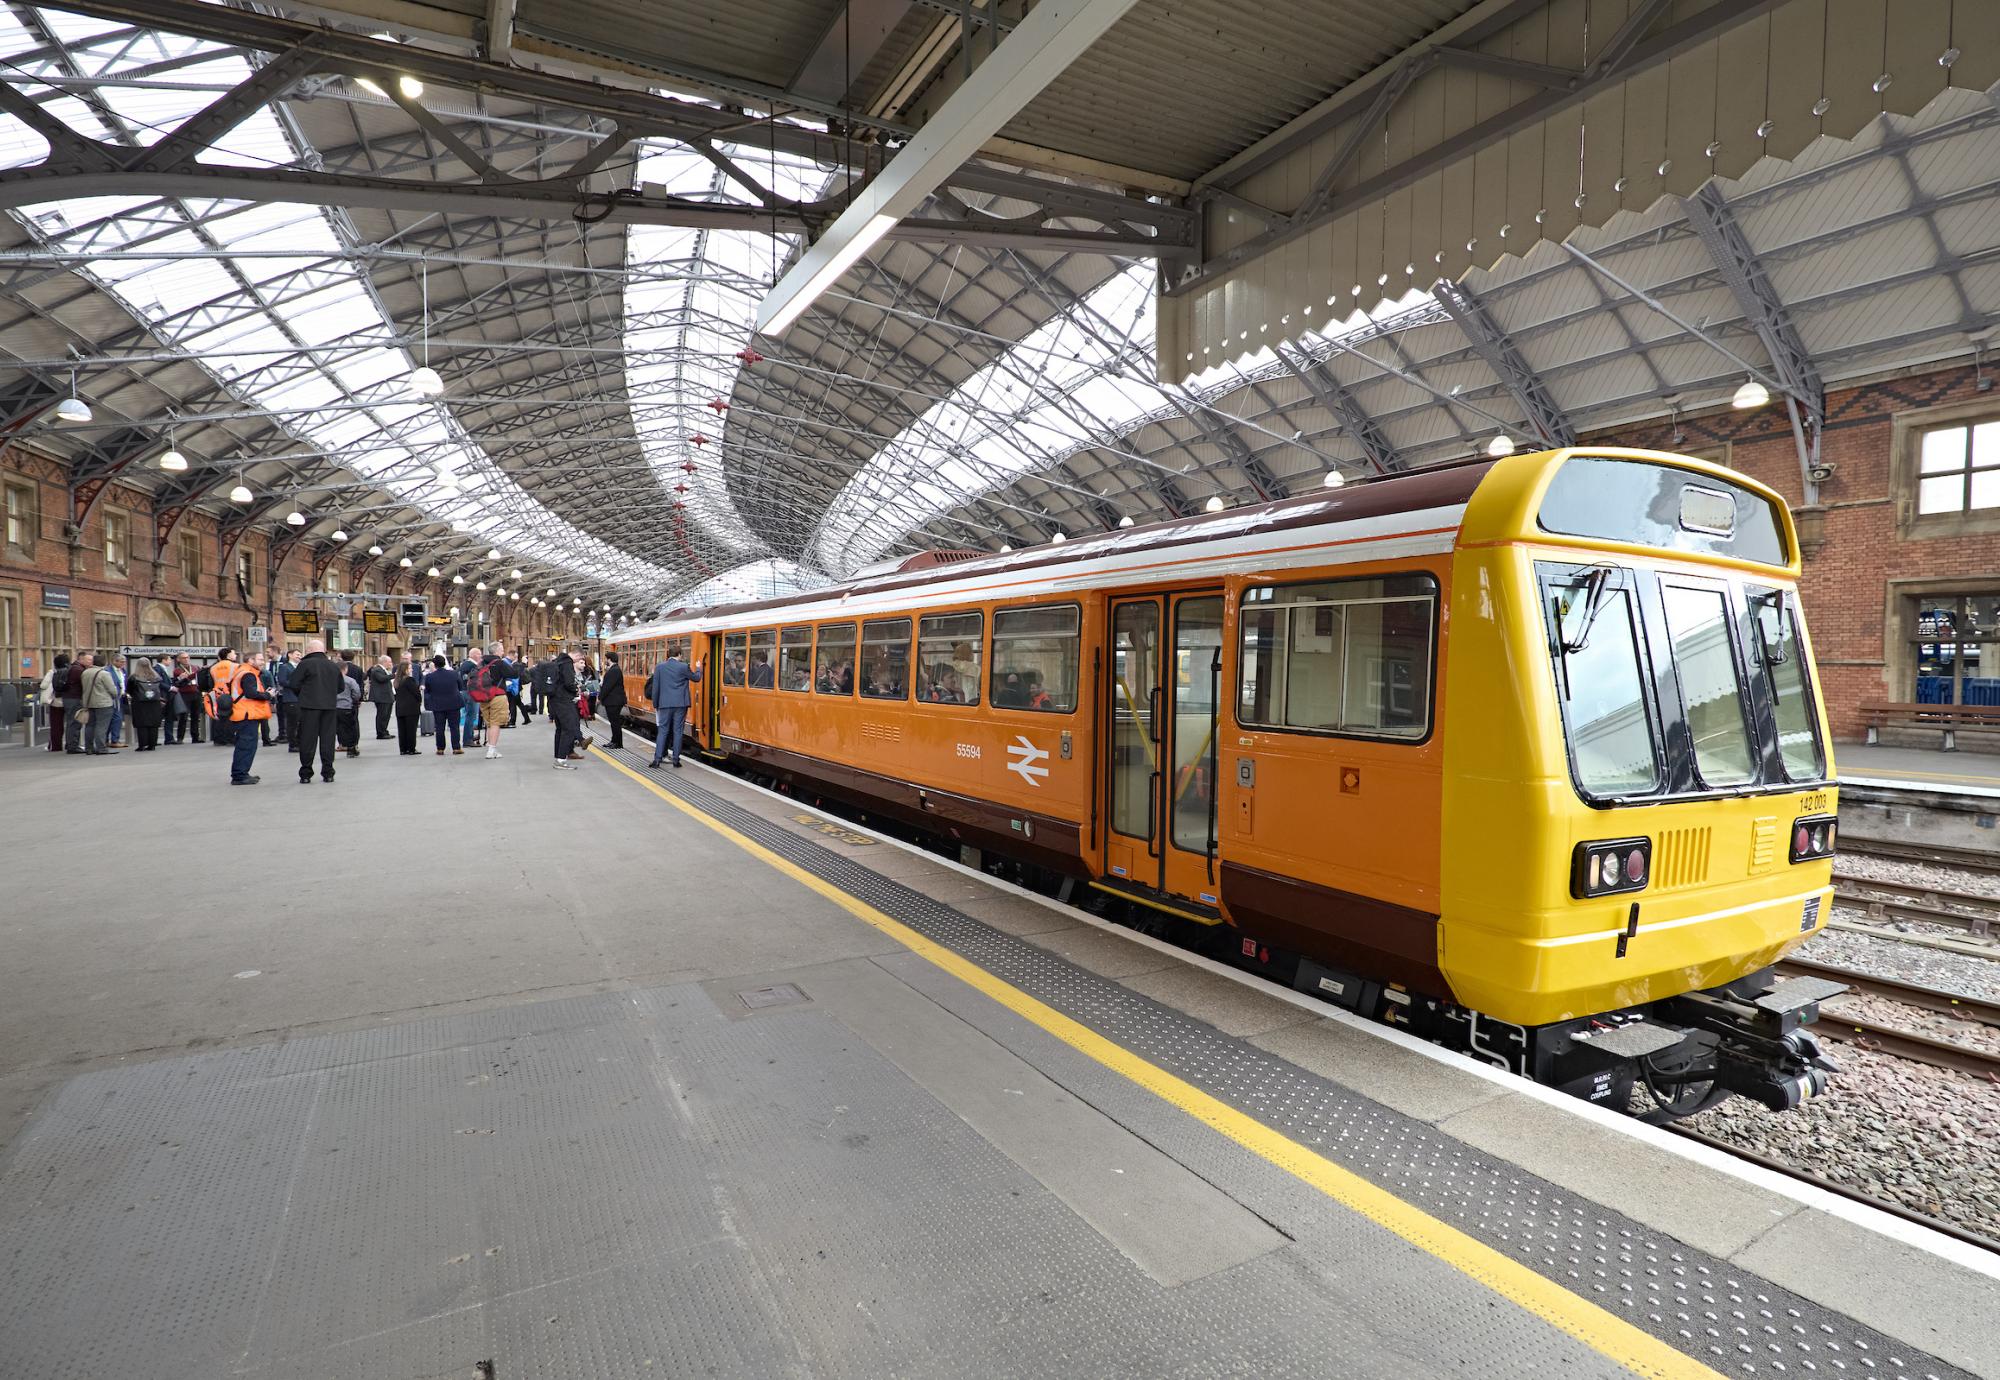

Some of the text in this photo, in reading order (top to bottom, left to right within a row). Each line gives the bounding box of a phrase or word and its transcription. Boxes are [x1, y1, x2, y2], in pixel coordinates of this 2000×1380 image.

[956, 743, 981, 759] 55594
[1800, 793, 1827, 812] 142 003
[1590, 1089, 1612, 1100] COUPLING
